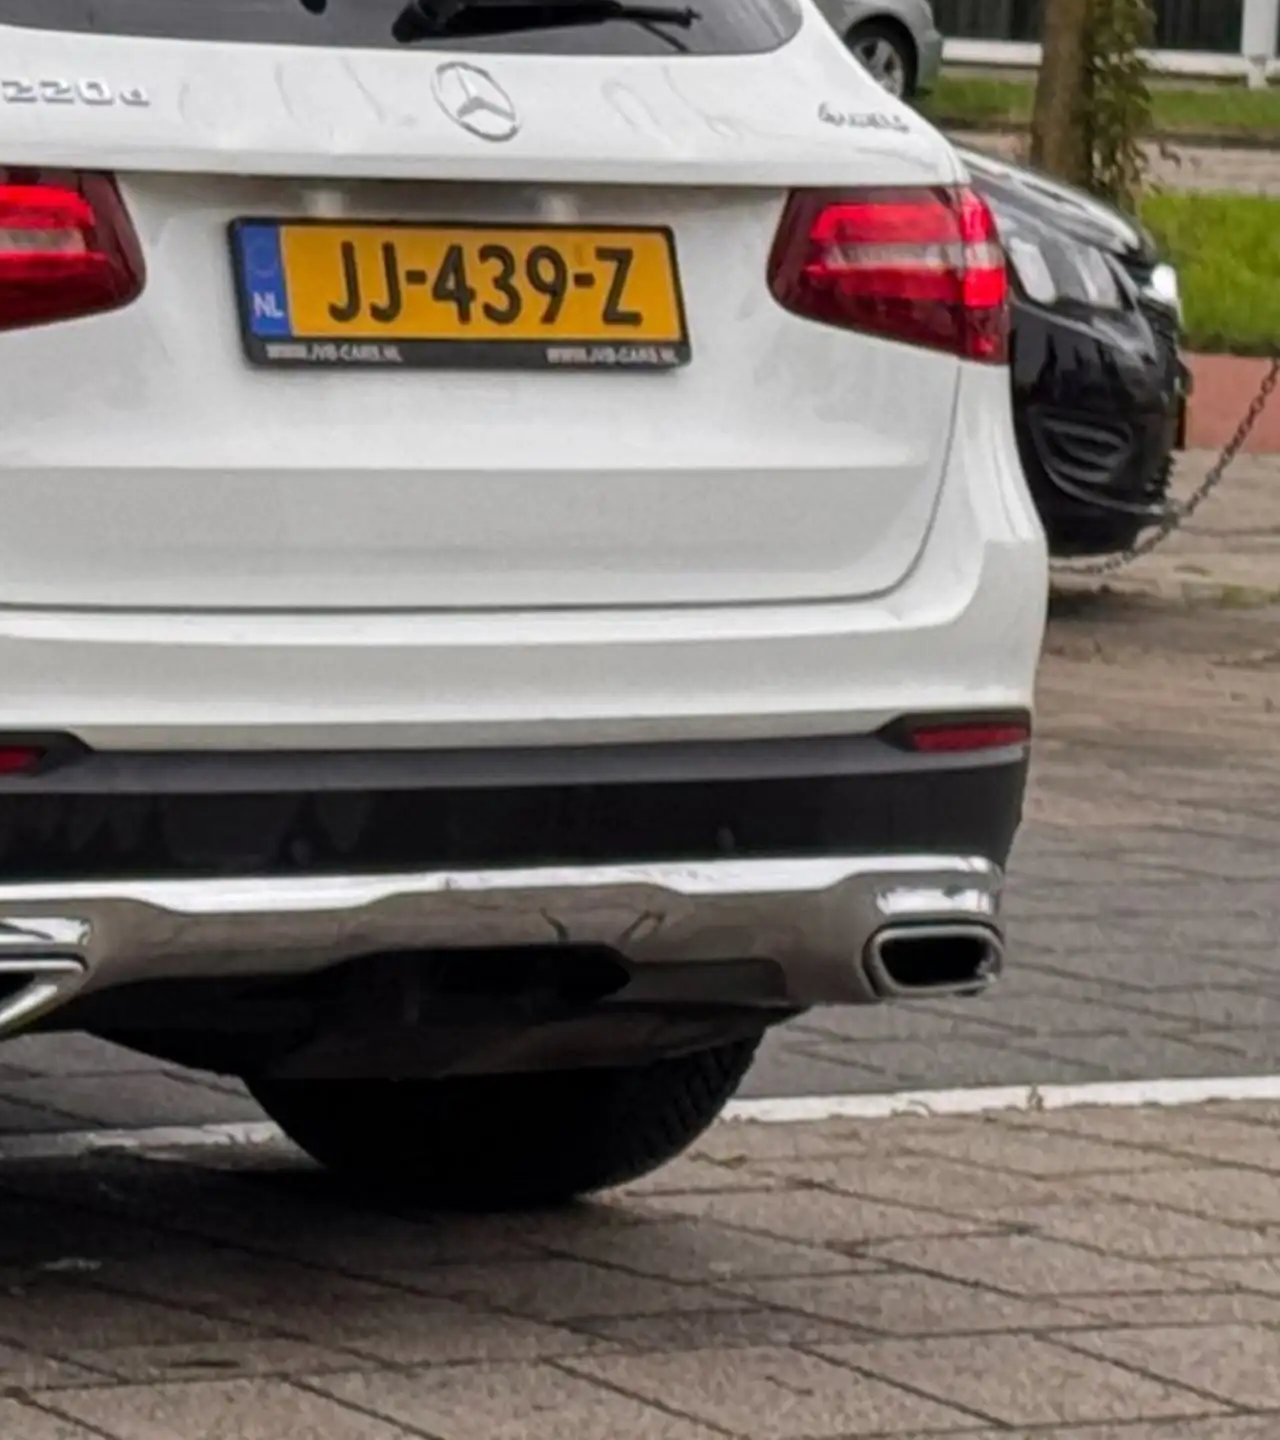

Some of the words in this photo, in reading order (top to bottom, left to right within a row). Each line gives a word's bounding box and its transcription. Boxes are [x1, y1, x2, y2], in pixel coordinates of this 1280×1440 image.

[0, 77, 152, 108] 220d
[327, 240, 644, 328] JJ-439-Z
[253, 291, 285, 319] NL
